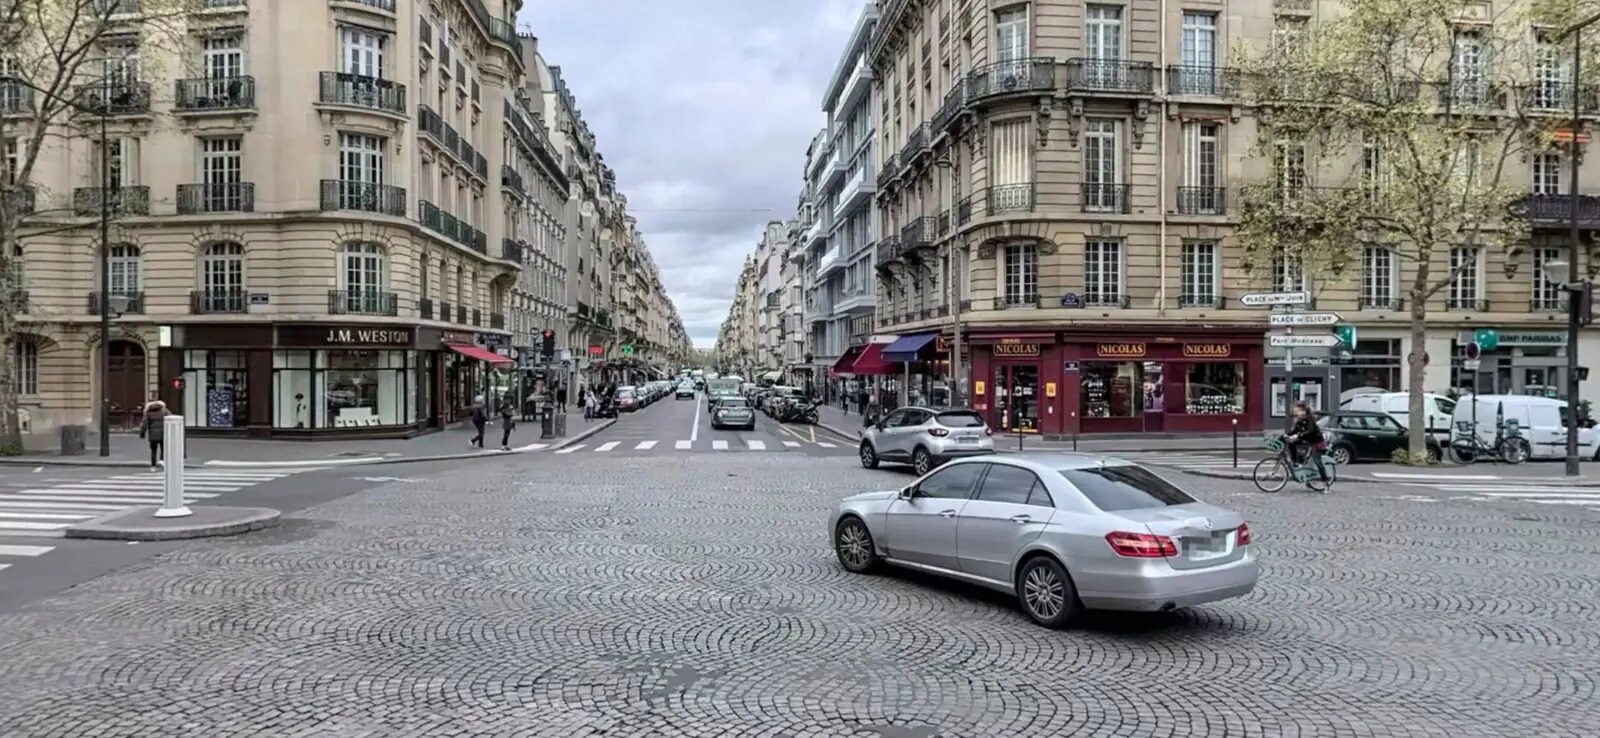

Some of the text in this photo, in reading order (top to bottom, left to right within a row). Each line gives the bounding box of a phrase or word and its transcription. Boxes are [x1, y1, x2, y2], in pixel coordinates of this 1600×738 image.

[326, 329, 409, 343] J.M. WESTON
[996, 344, 1037, 353] NICOLAS
[1100, 344, 1143, 354] NICOLAS
[1186, 344, 1227, 354] NICOLAS
